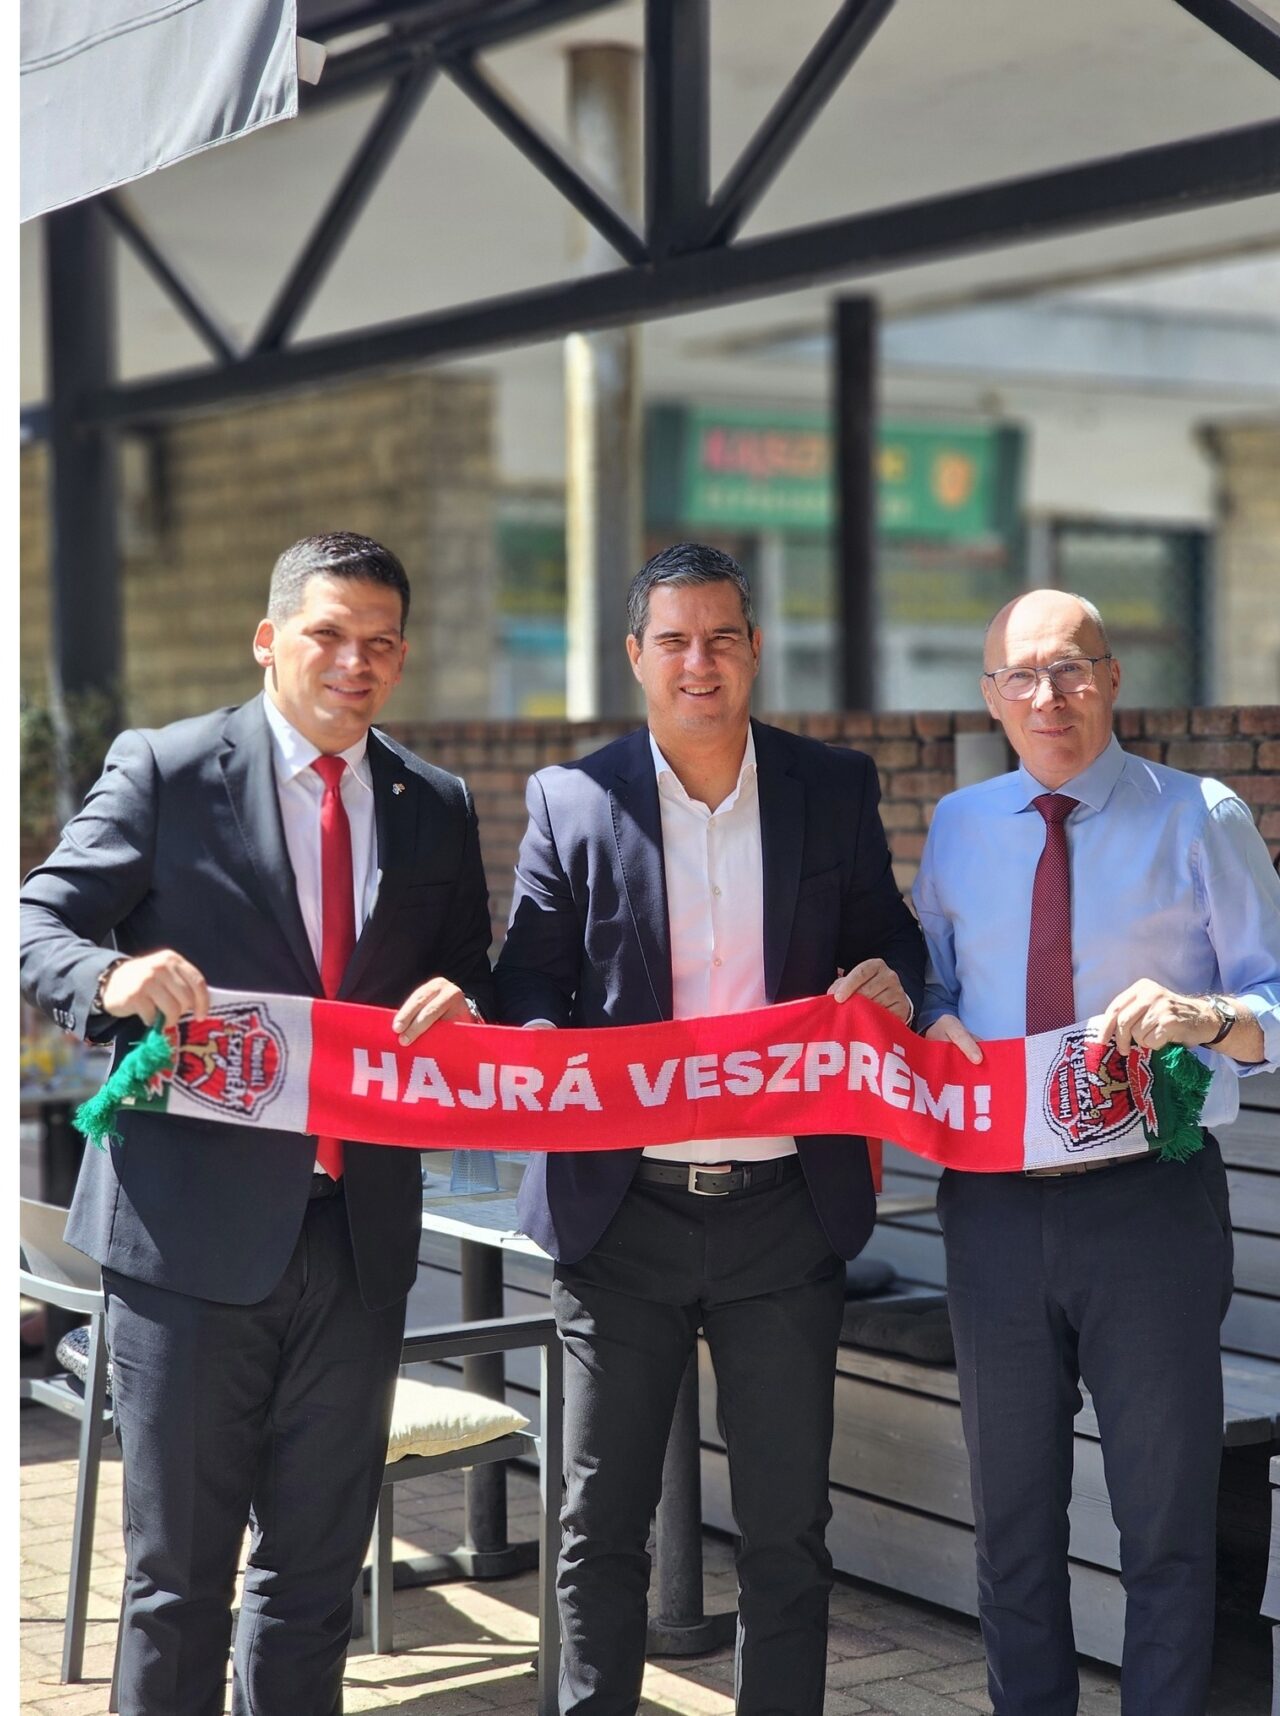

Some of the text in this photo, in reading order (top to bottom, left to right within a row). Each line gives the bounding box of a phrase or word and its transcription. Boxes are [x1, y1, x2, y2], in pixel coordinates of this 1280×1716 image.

[351, 1041, 991, 1132] HAJRÁ VESZPRÉM!
[1071, 1037, 1104, 1140] VESZPRÉM
